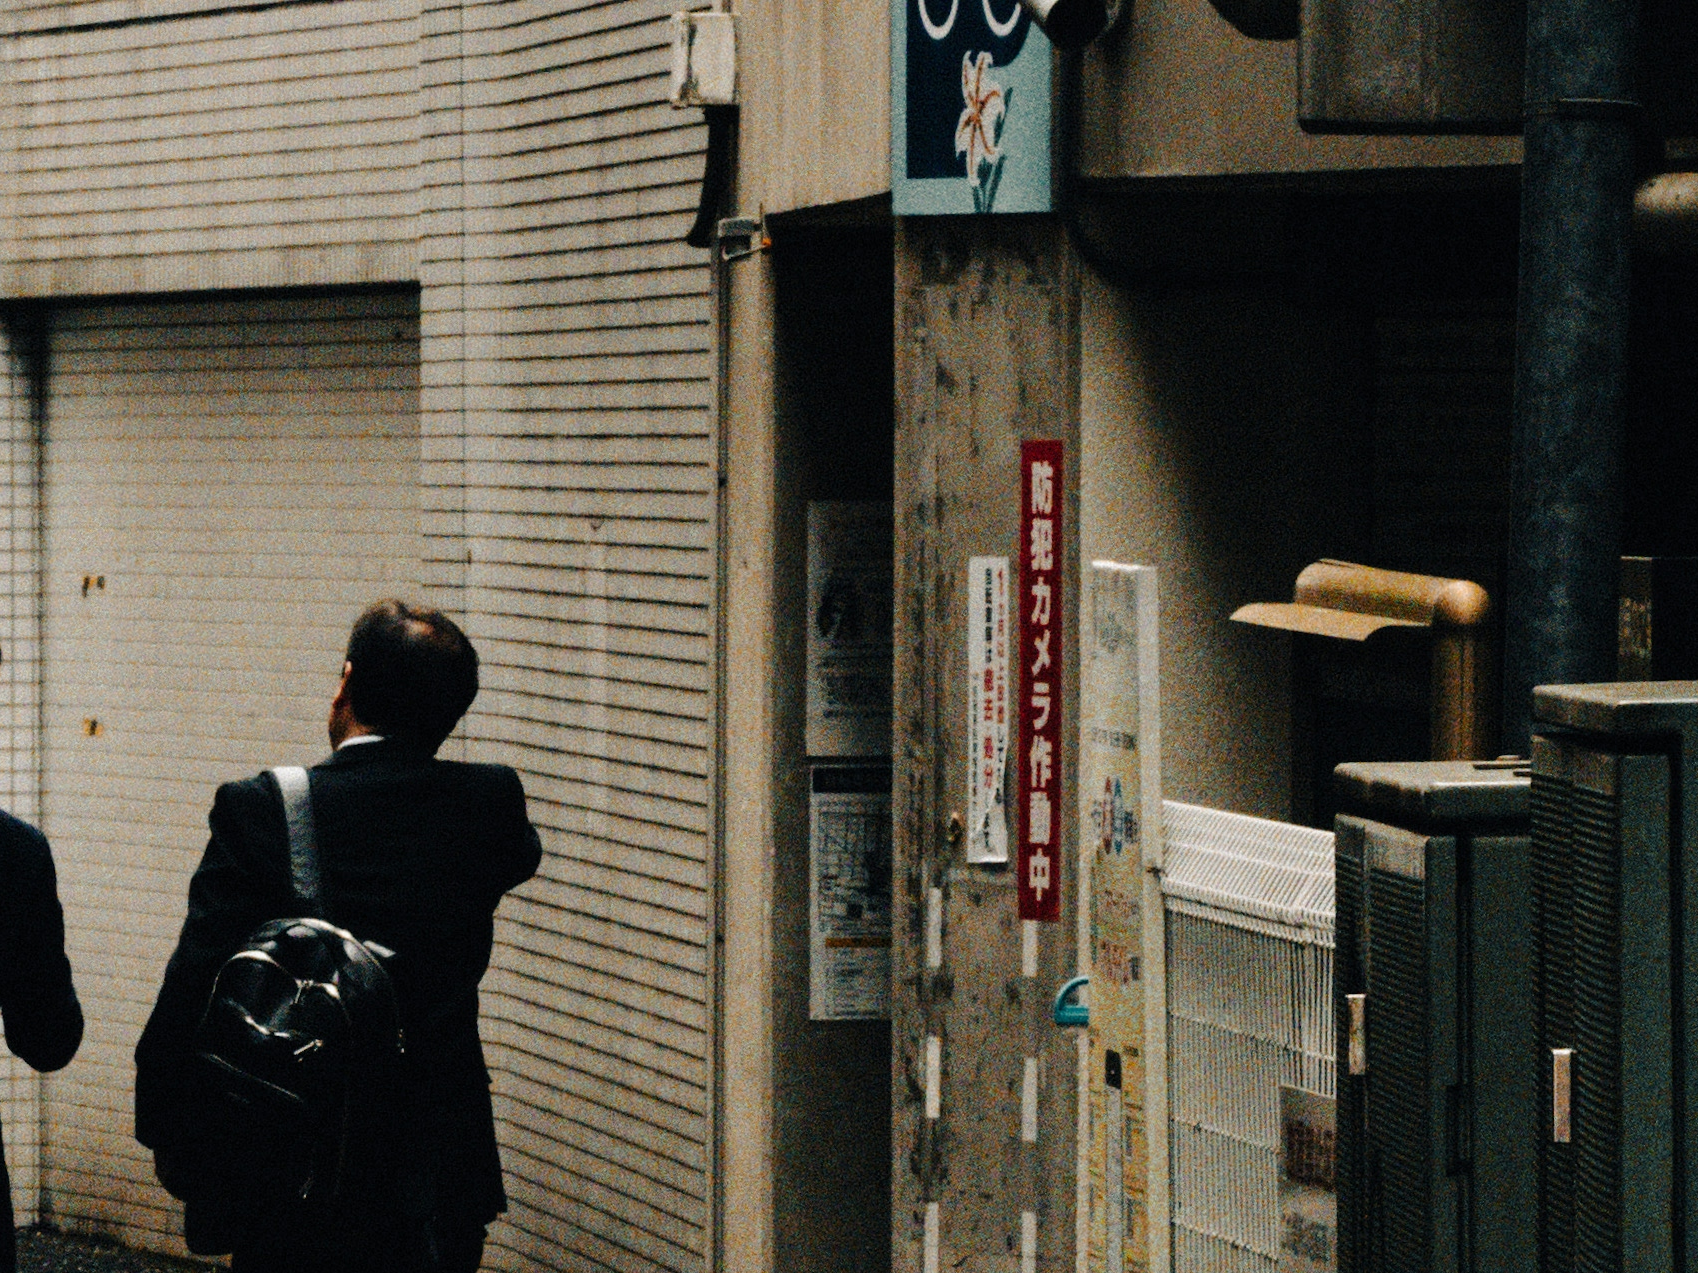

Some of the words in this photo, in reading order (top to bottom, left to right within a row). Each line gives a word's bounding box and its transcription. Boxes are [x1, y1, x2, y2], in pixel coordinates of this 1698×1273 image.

[1028, 460, 1055, 902] 防犯カメラ作動中
